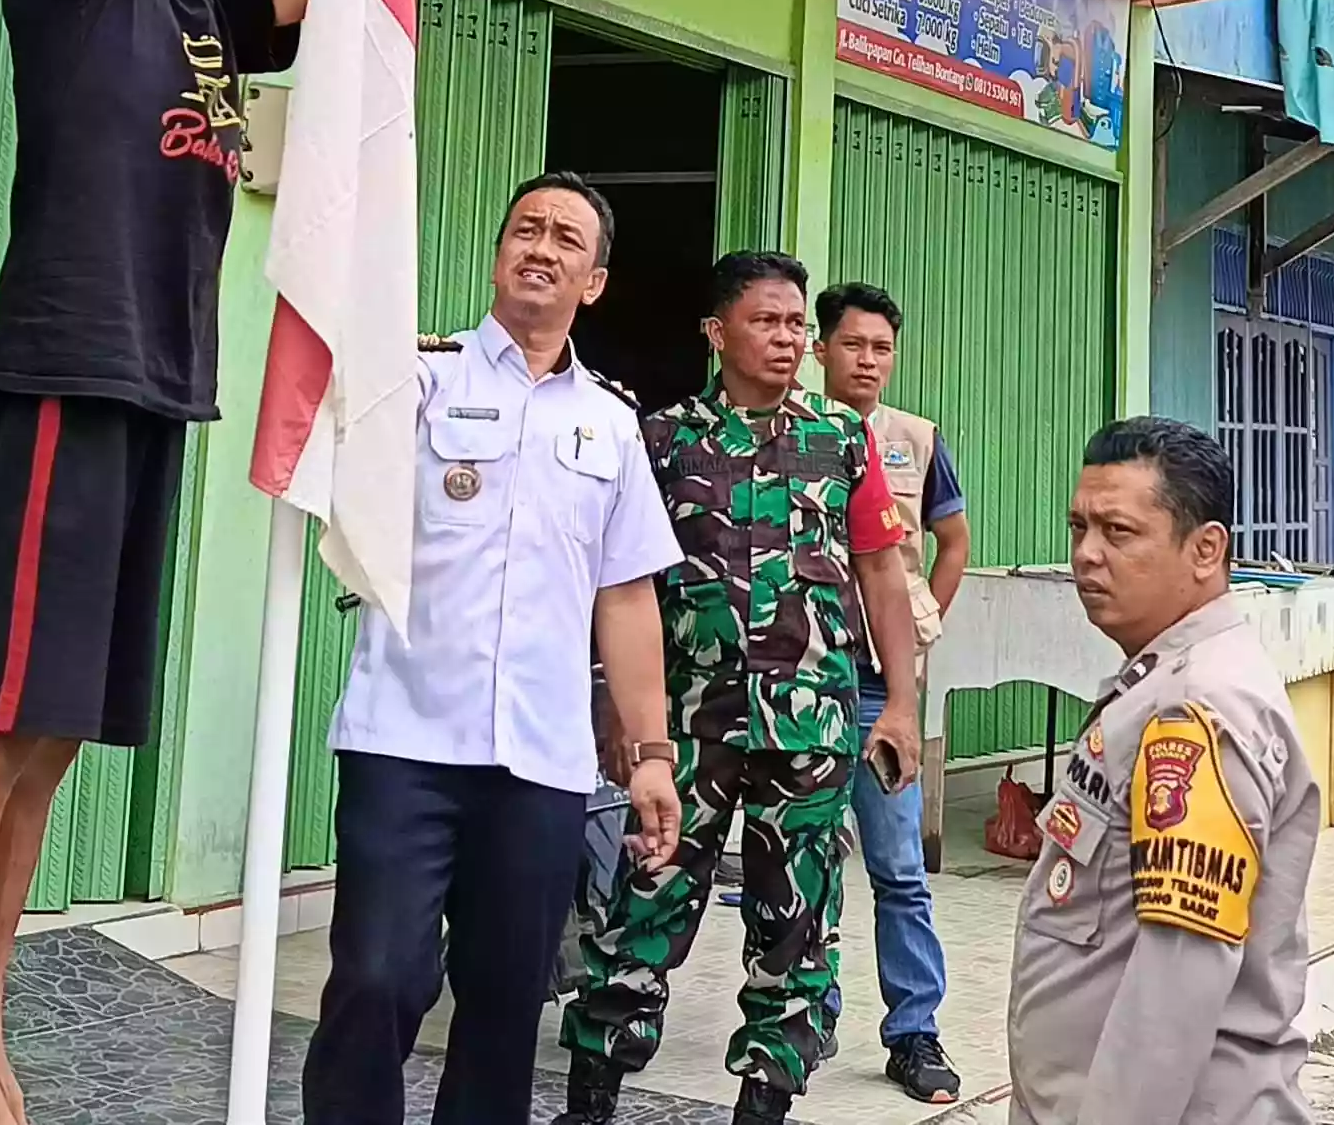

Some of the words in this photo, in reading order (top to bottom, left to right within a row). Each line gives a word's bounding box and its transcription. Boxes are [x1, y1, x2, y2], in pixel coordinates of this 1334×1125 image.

[945, 19, 958, 54] kg
[977, 6, 1009, 39] Sepatu
[1017, 22, 1033, 48] Tas
[976, 33, 1001, 65] Helm
